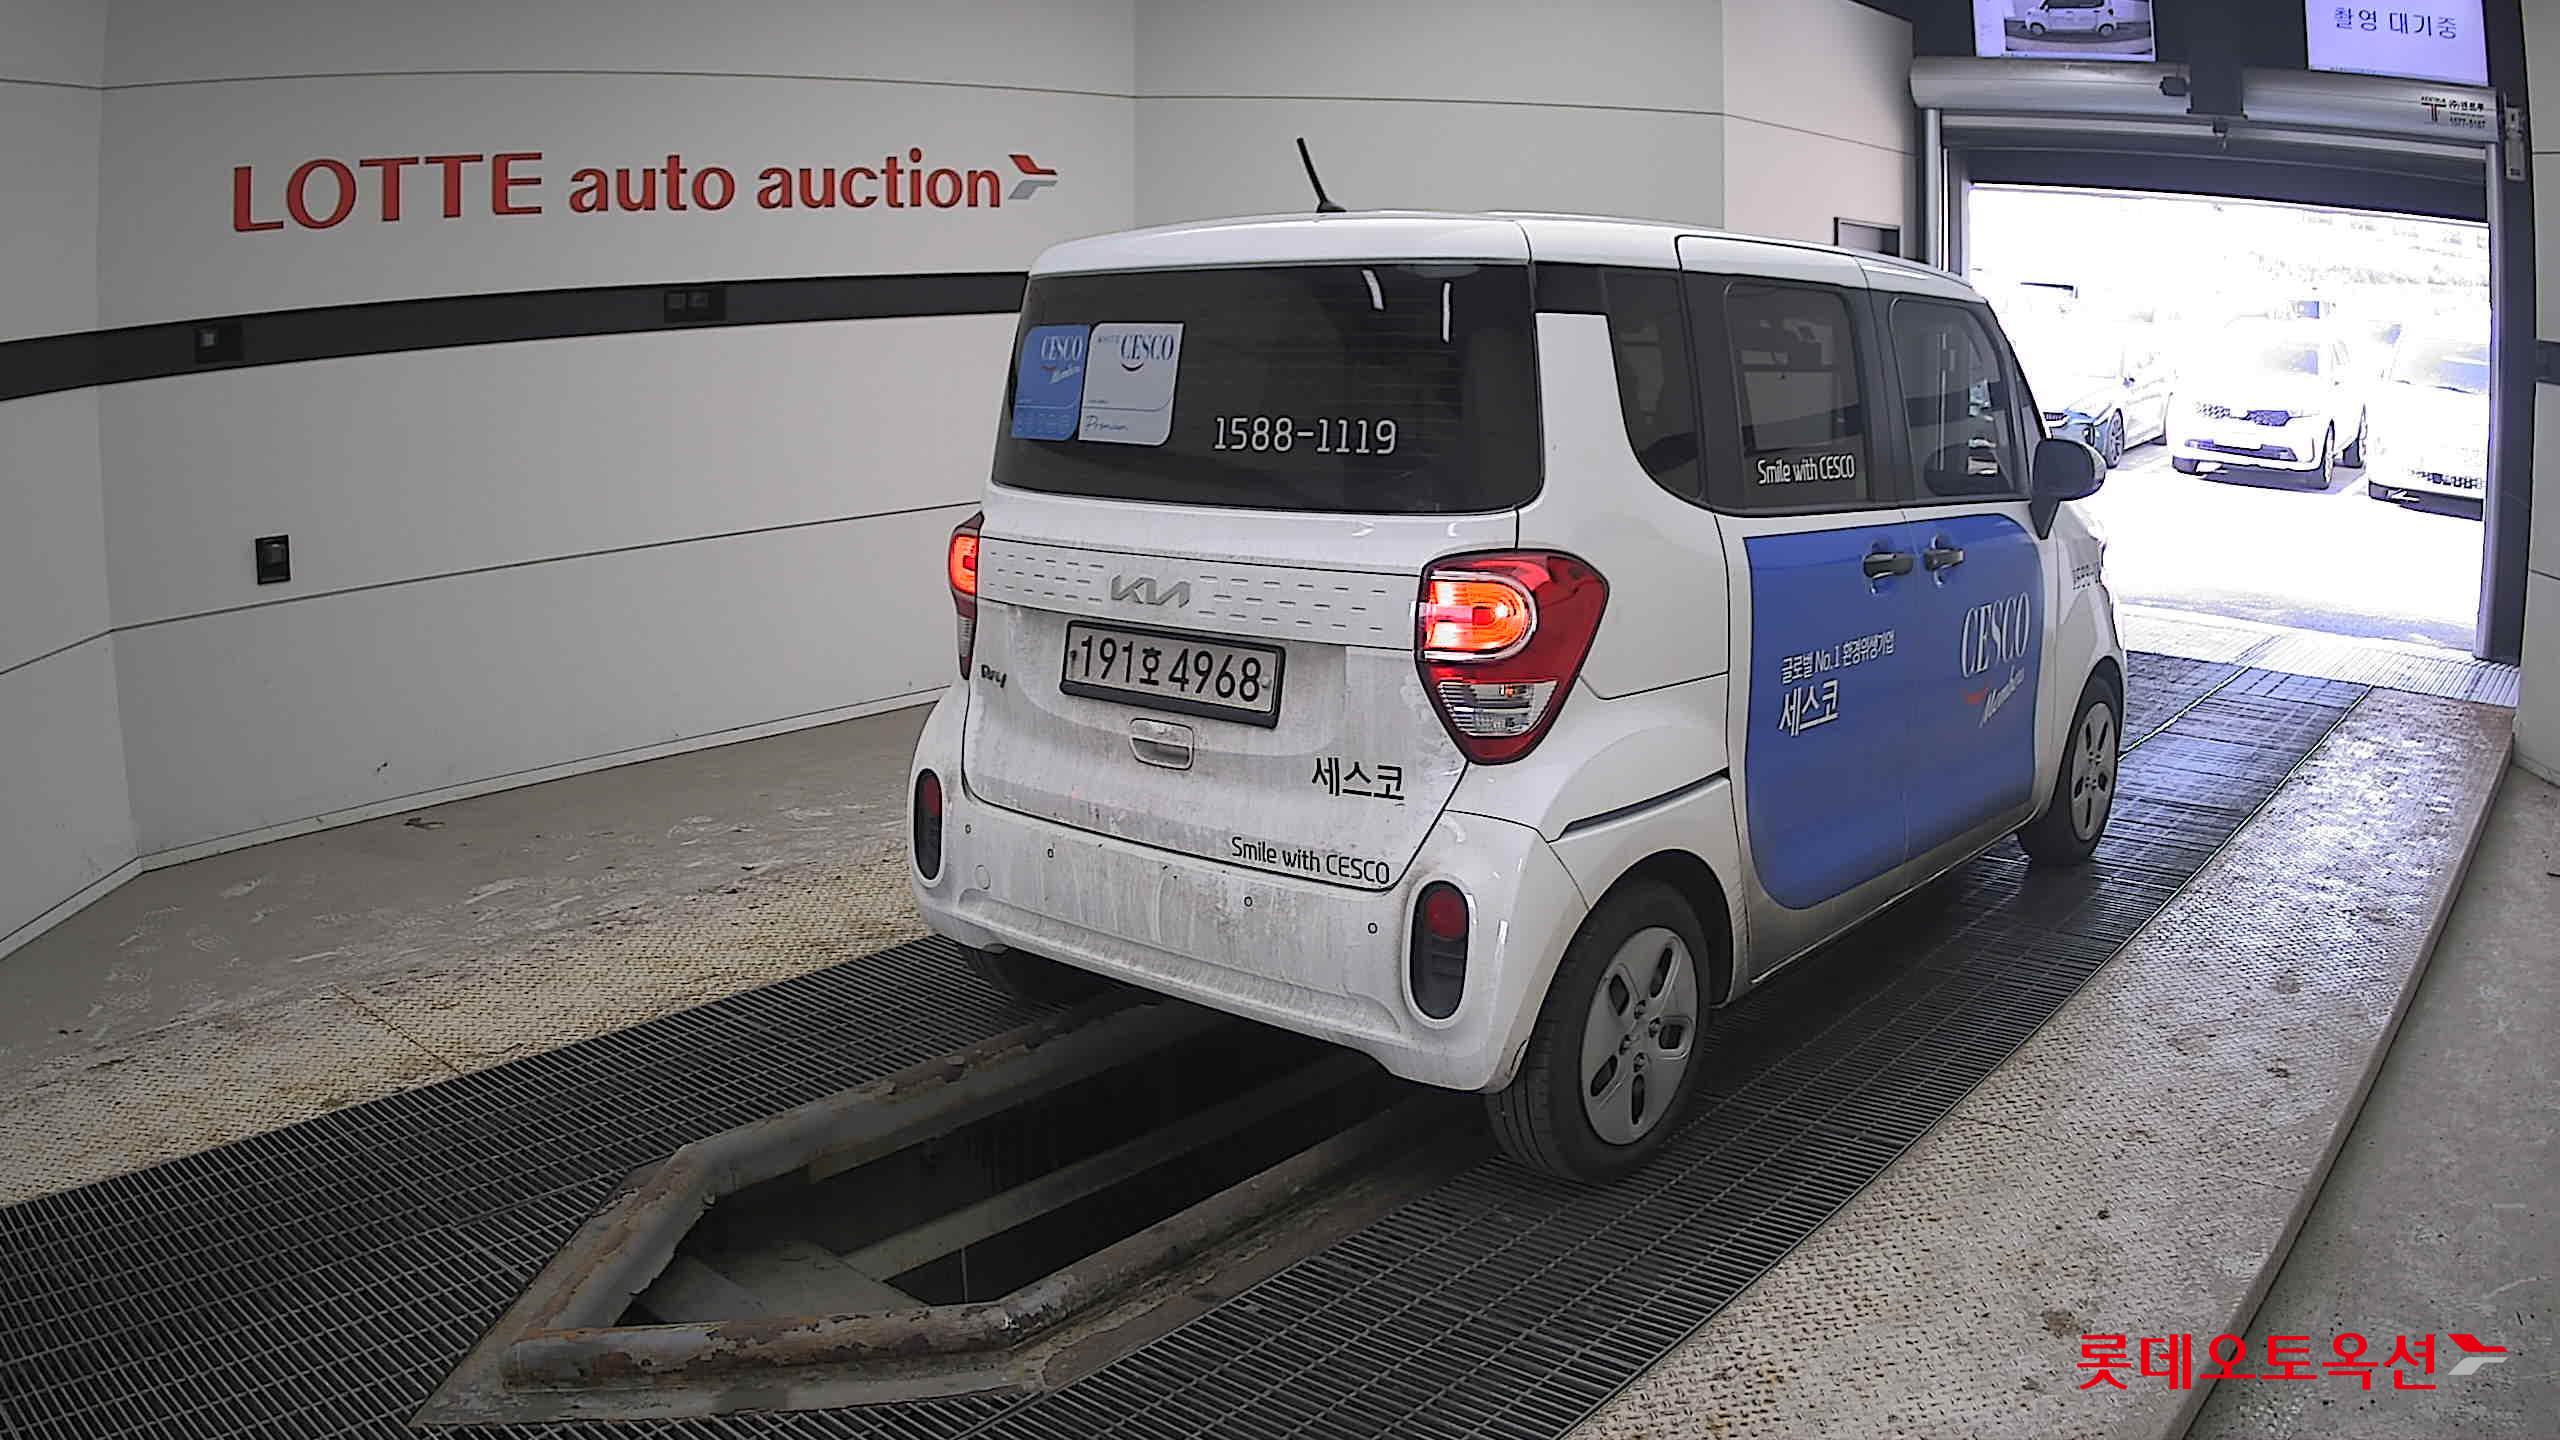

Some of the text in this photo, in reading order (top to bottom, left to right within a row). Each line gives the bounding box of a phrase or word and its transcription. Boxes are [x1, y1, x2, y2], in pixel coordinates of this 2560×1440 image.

[2388, 11, 2457, 40] 대기중
[232, 147, 1001, 232] LOTTE auto auction
[1040, 334, 1084, 361] CESCO
[1120, 333, 1175, 361] CESCO
[1213, 416, 1398, 455] 1588-1119
[1757, 455, 1856, 485] Smile with CESCO
[1111, 574, 1191, 608] KIA
[1961, 591, 2030, 678] CESCO
[1781, 651, 1814, 684] 글로벌
[1814, 645, 1840, 673] No.1
[1778, 679, 1839, 737] 세스코
[1311, 756, 1405, 801] 세스코
[1231, 836, 1390, 885] Smile with CESCO
